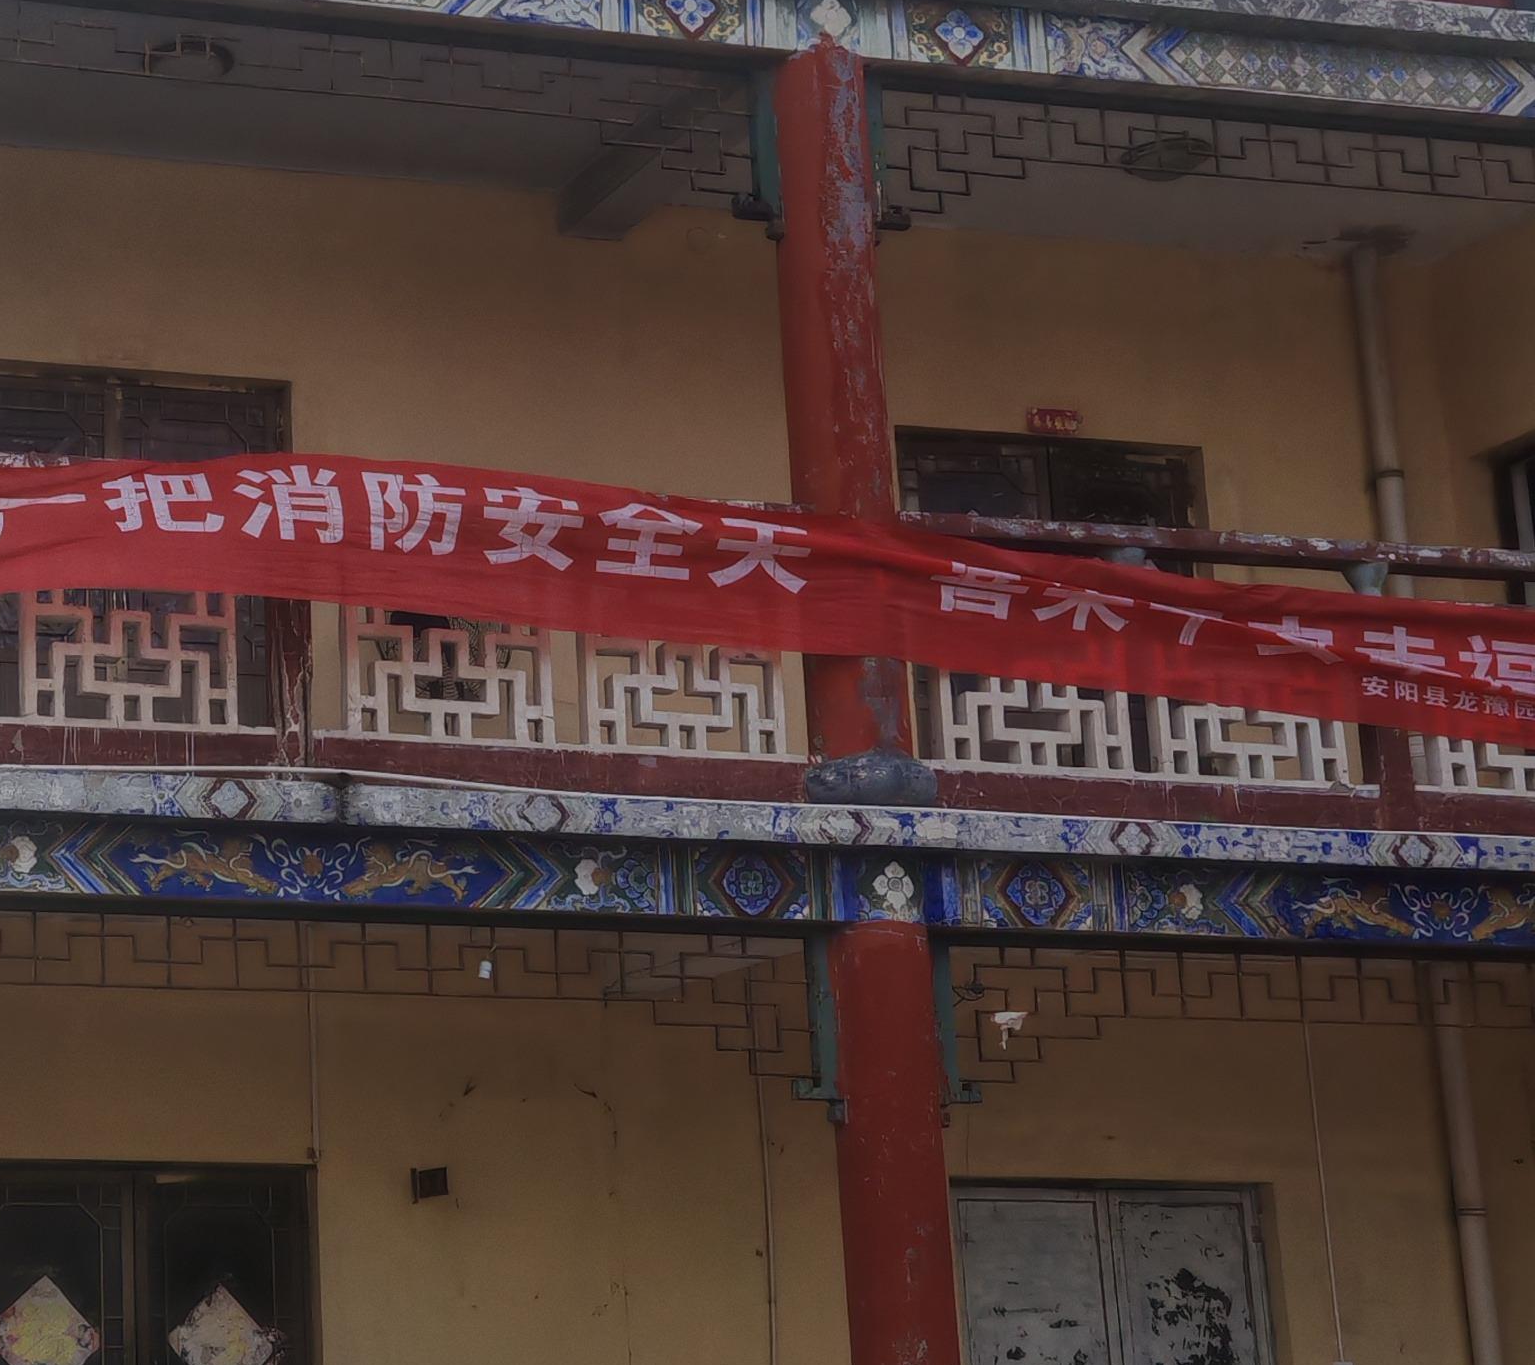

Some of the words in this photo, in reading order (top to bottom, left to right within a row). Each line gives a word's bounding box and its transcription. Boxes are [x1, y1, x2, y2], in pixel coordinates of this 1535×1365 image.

[1361, 675, 1535, 720] 安阳县龙豫园
